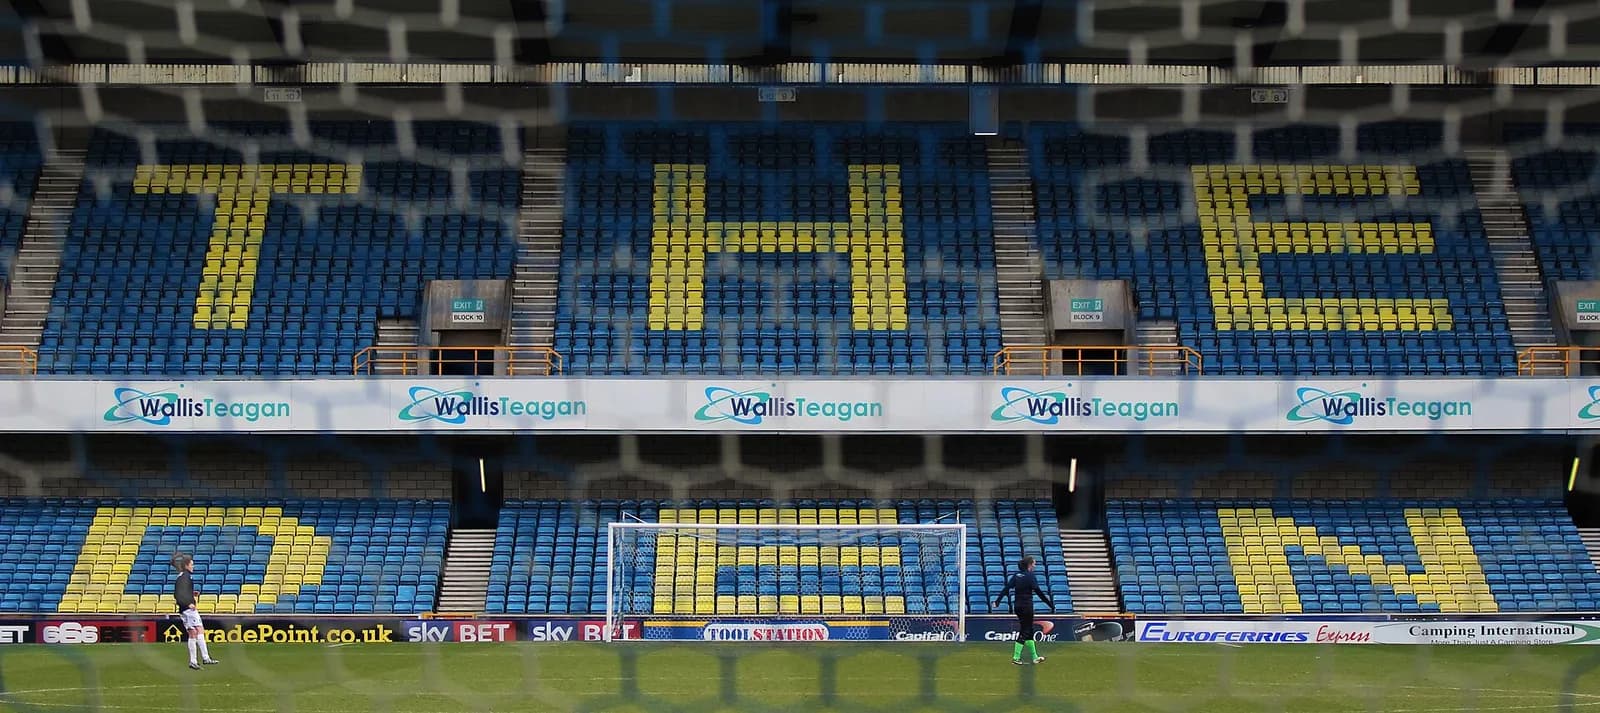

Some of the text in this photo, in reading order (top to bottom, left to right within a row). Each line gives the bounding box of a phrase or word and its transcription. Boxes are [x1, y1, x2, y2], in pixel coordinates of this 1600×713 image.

[454, 301, 473, 309] EXIT
[1072, 301, 1090, 309] EXIT
[1578, 302, 1596, 310] EXIT
[100, 626, 149, 643] BET
[408, 622, 510, 642] sky BET
[532, 622, 573, 641] sky
[1316, 625, 1371, 643] Express
[1409, 625, 1576, 638] Camping International
